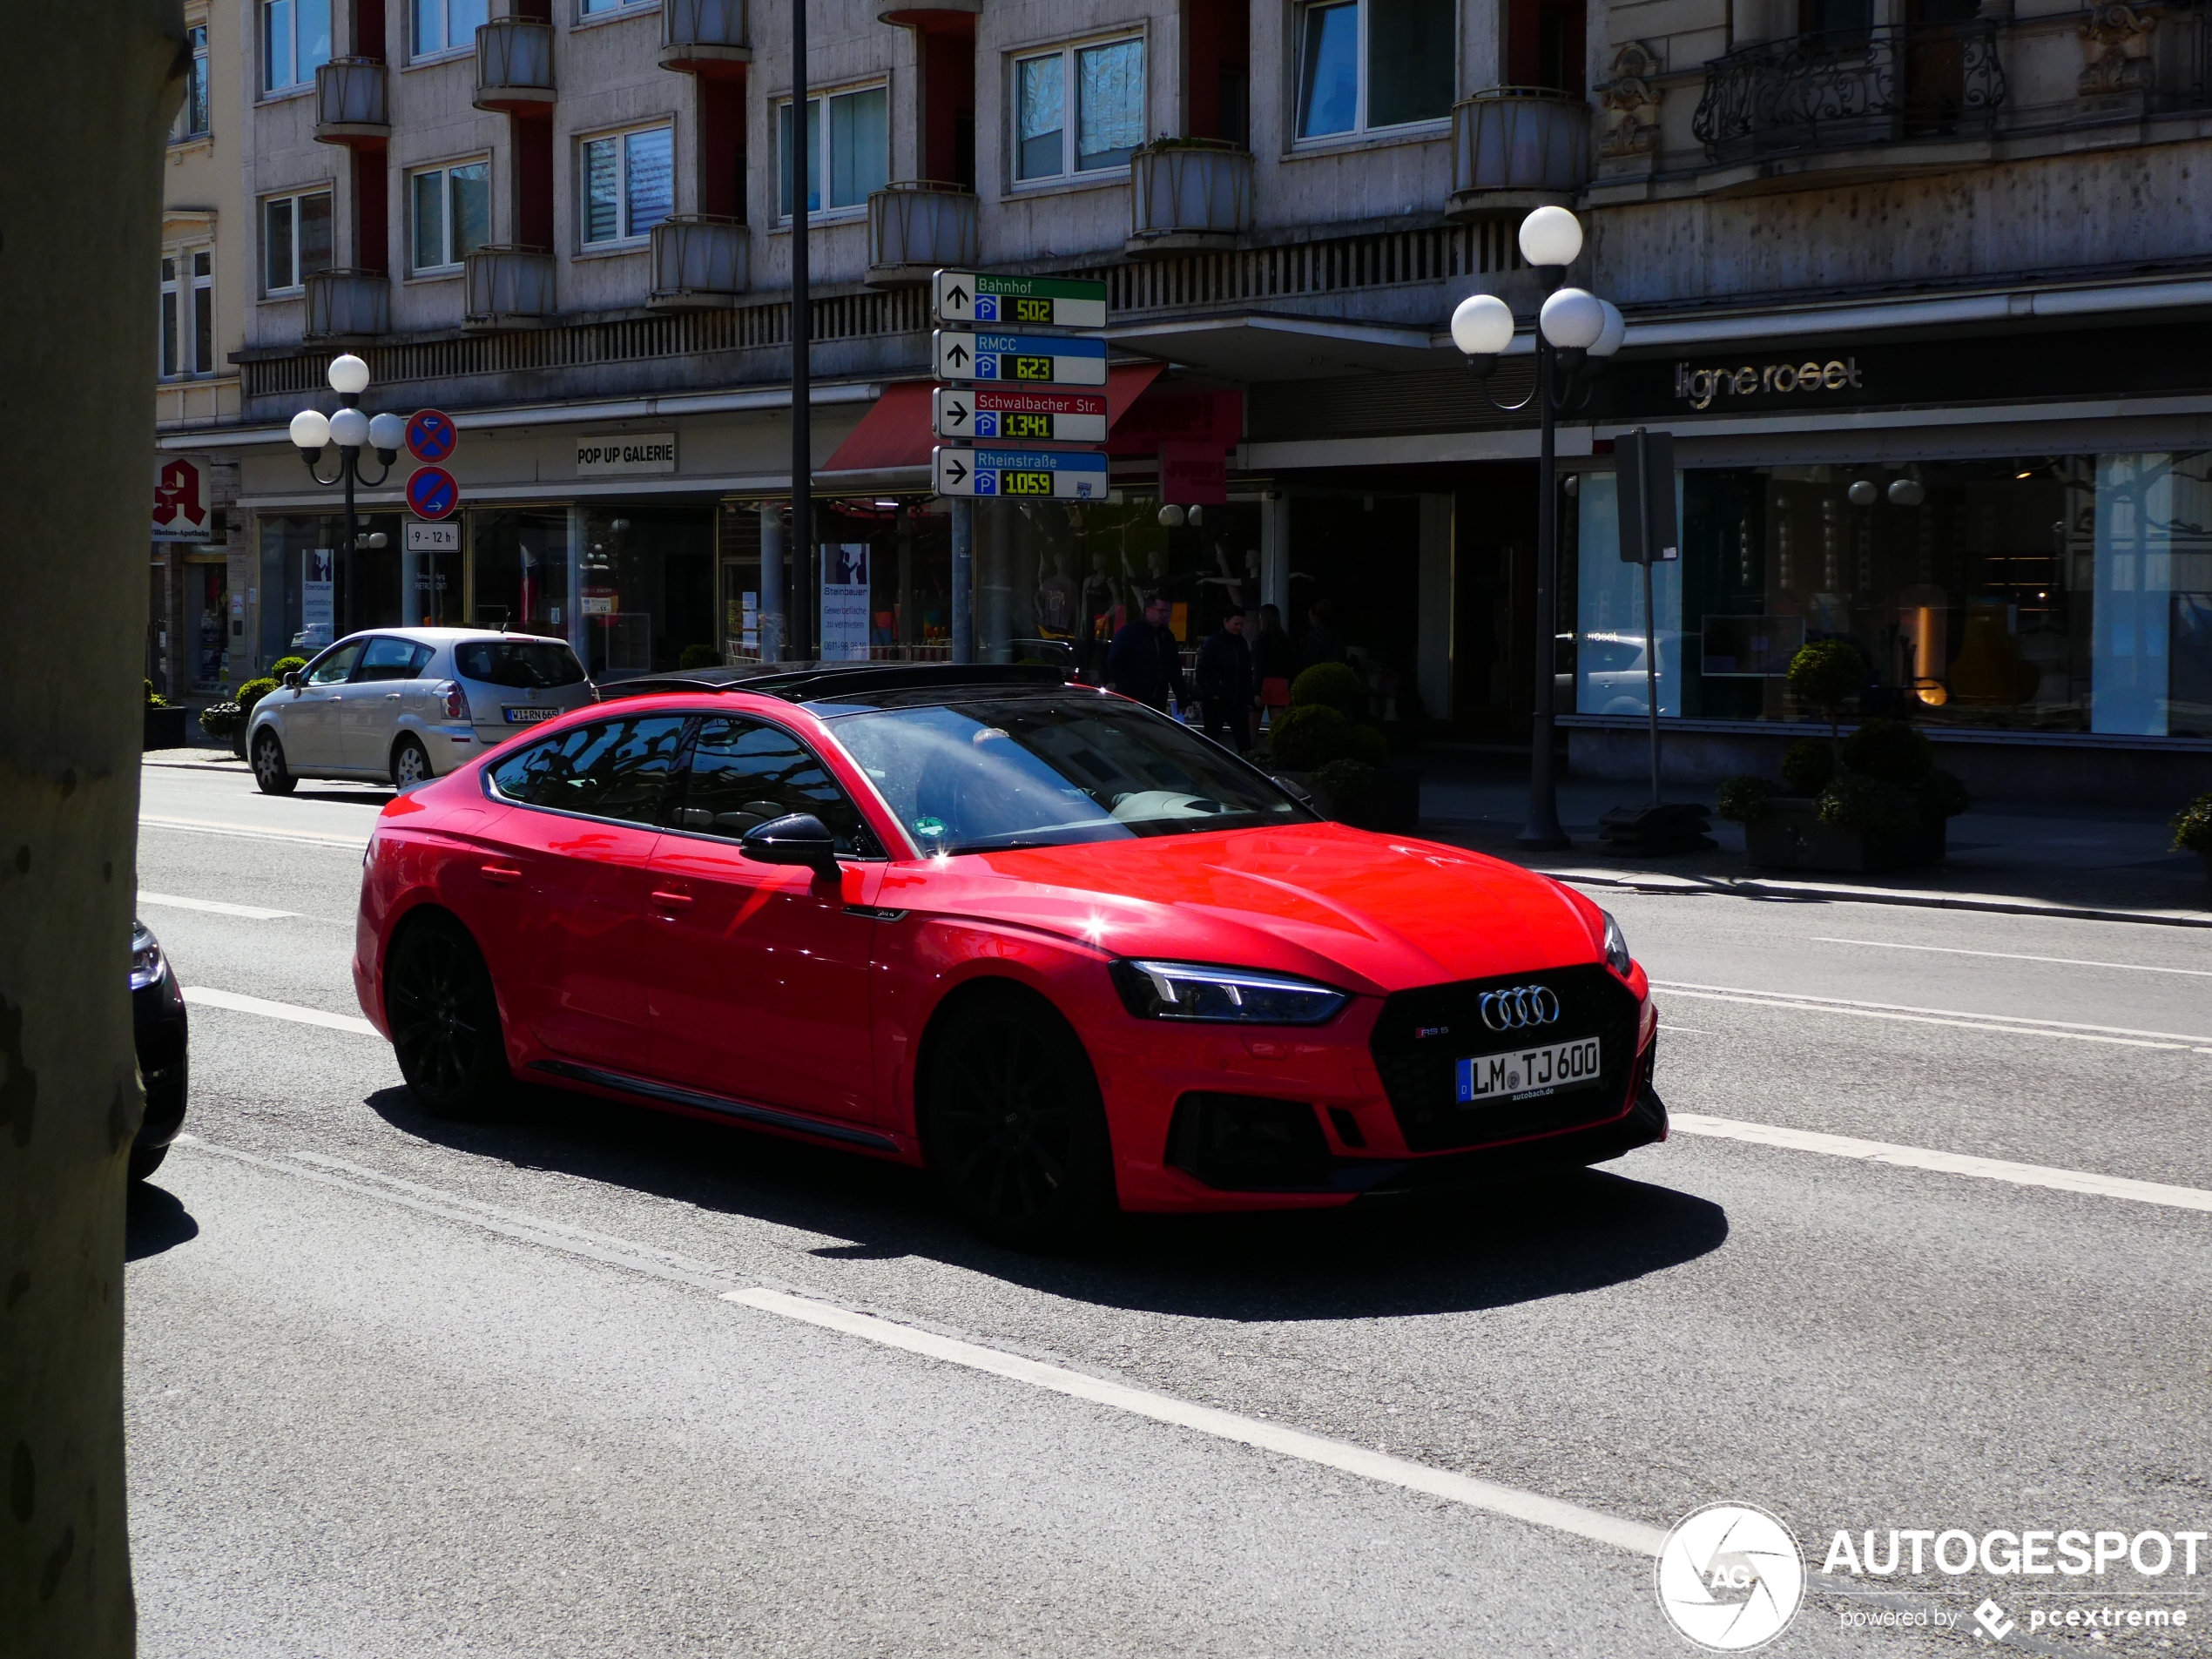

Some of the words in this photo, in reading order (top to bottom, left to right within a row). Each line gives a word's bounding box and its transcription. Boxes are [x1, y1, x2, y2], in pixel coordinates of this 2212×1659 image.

[979, 279, 1032, 294] Bahnhof
[1017, 300, 1050, 321] 502
[979, 337, 1016, 351] RMCC
[1017, 358, 1050, 380] 623
[1675, 362, 1759, 410] ligne
[1763, 356, 1863, 393] roset
[979, 395, 1069, 411] Schwalbacher
[1076, 399, 1097, 413] Str.
[1006, 415, 1050, 436] 1341
[578, 448, 602, 464] POP
[604, 447, 620, 463] UP
[624, 444, 673, 462] GALERIE
[979, 453, 1057, 469] Rheinstraße
[1006, 473, 1050, 495] 1059
[415, 532, 421, 543] 9
[433, 532, 442, 543] 12
[446, 532, 450, 543] h
[825, 587, 867, 596] Steinbauer
[825, 606, 867, 615] Gewerbefläche
[512, 711, 523, 719] WI
[1473, 1058, 1505, 1095] LM
[1461, 1085, 1467, 1095] D
[1513, 1088, 1554, 1101] autobach.de
